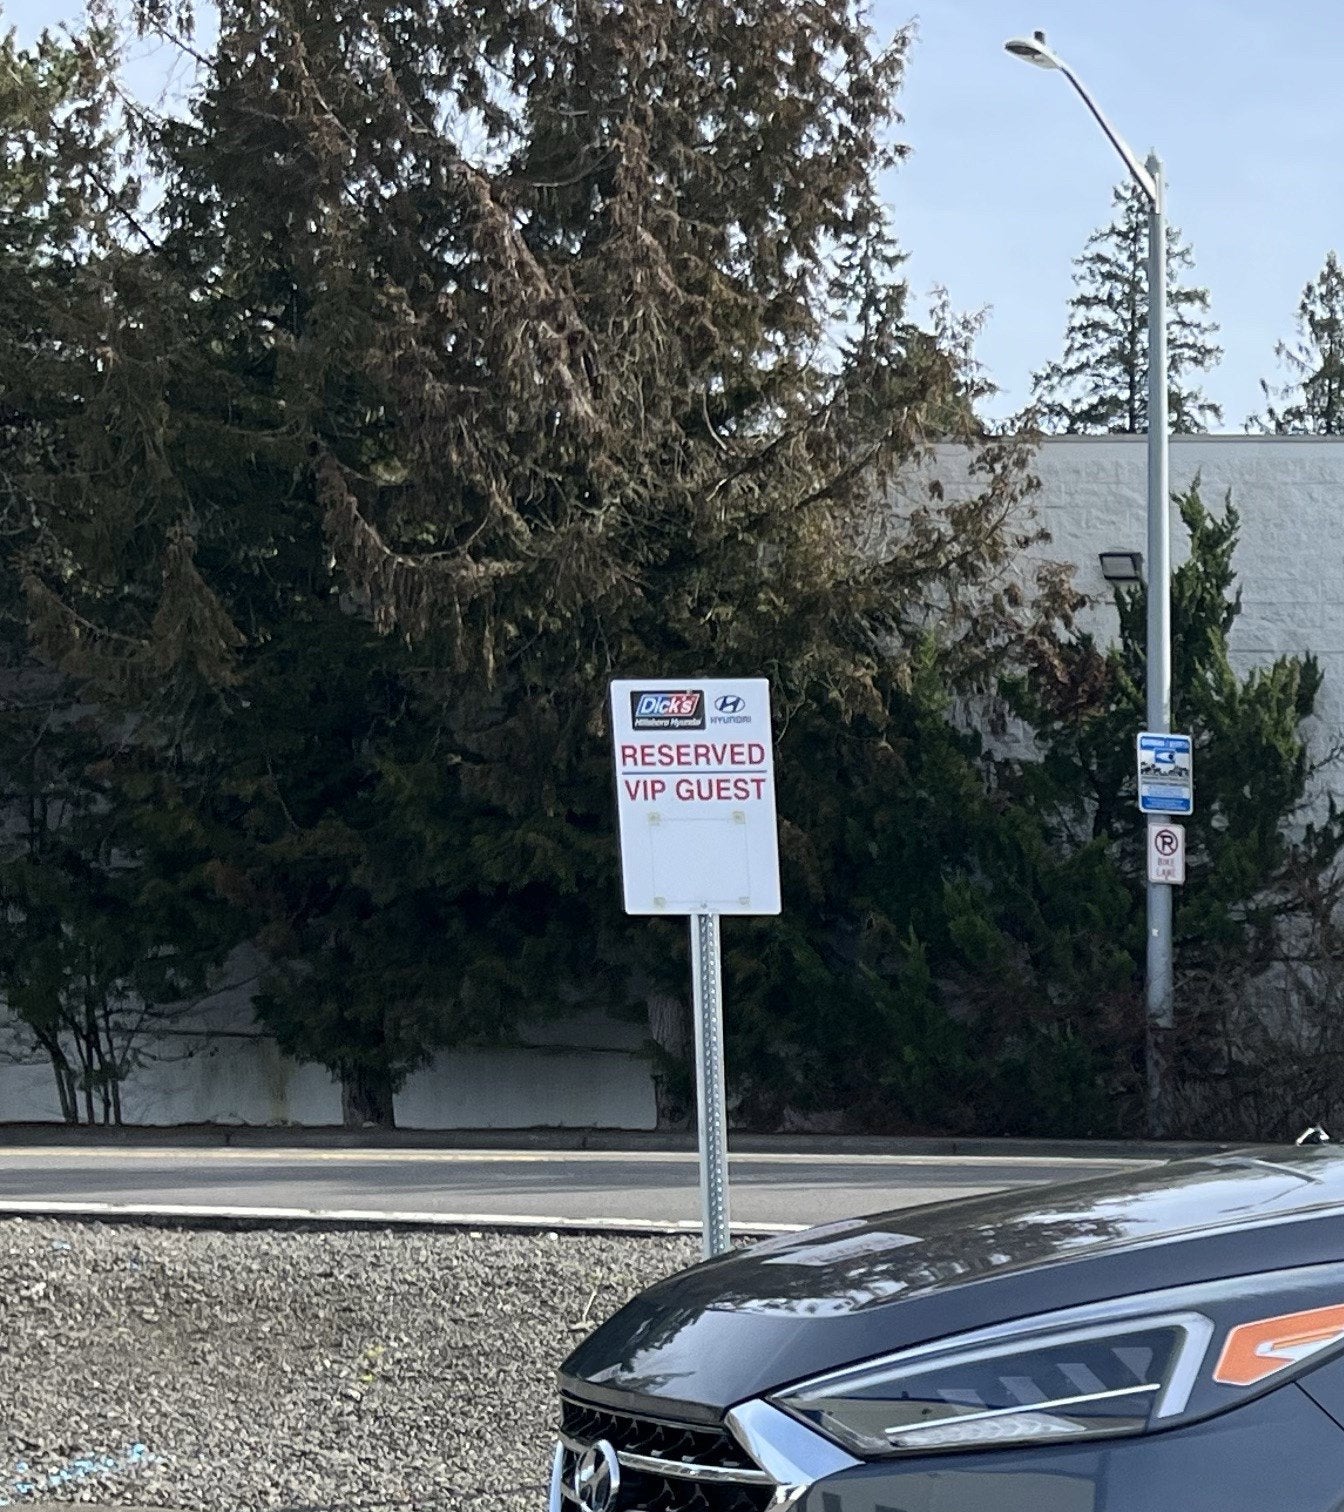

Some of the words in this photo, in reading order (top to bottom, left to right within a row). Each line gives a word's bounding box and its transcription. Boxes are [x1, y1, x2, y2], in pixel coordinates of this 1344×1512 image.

[621, 743, 765, 767] RESERVED
[624, 779, 666, 801] VIP
[675, 778, 766, 801] GUEST
